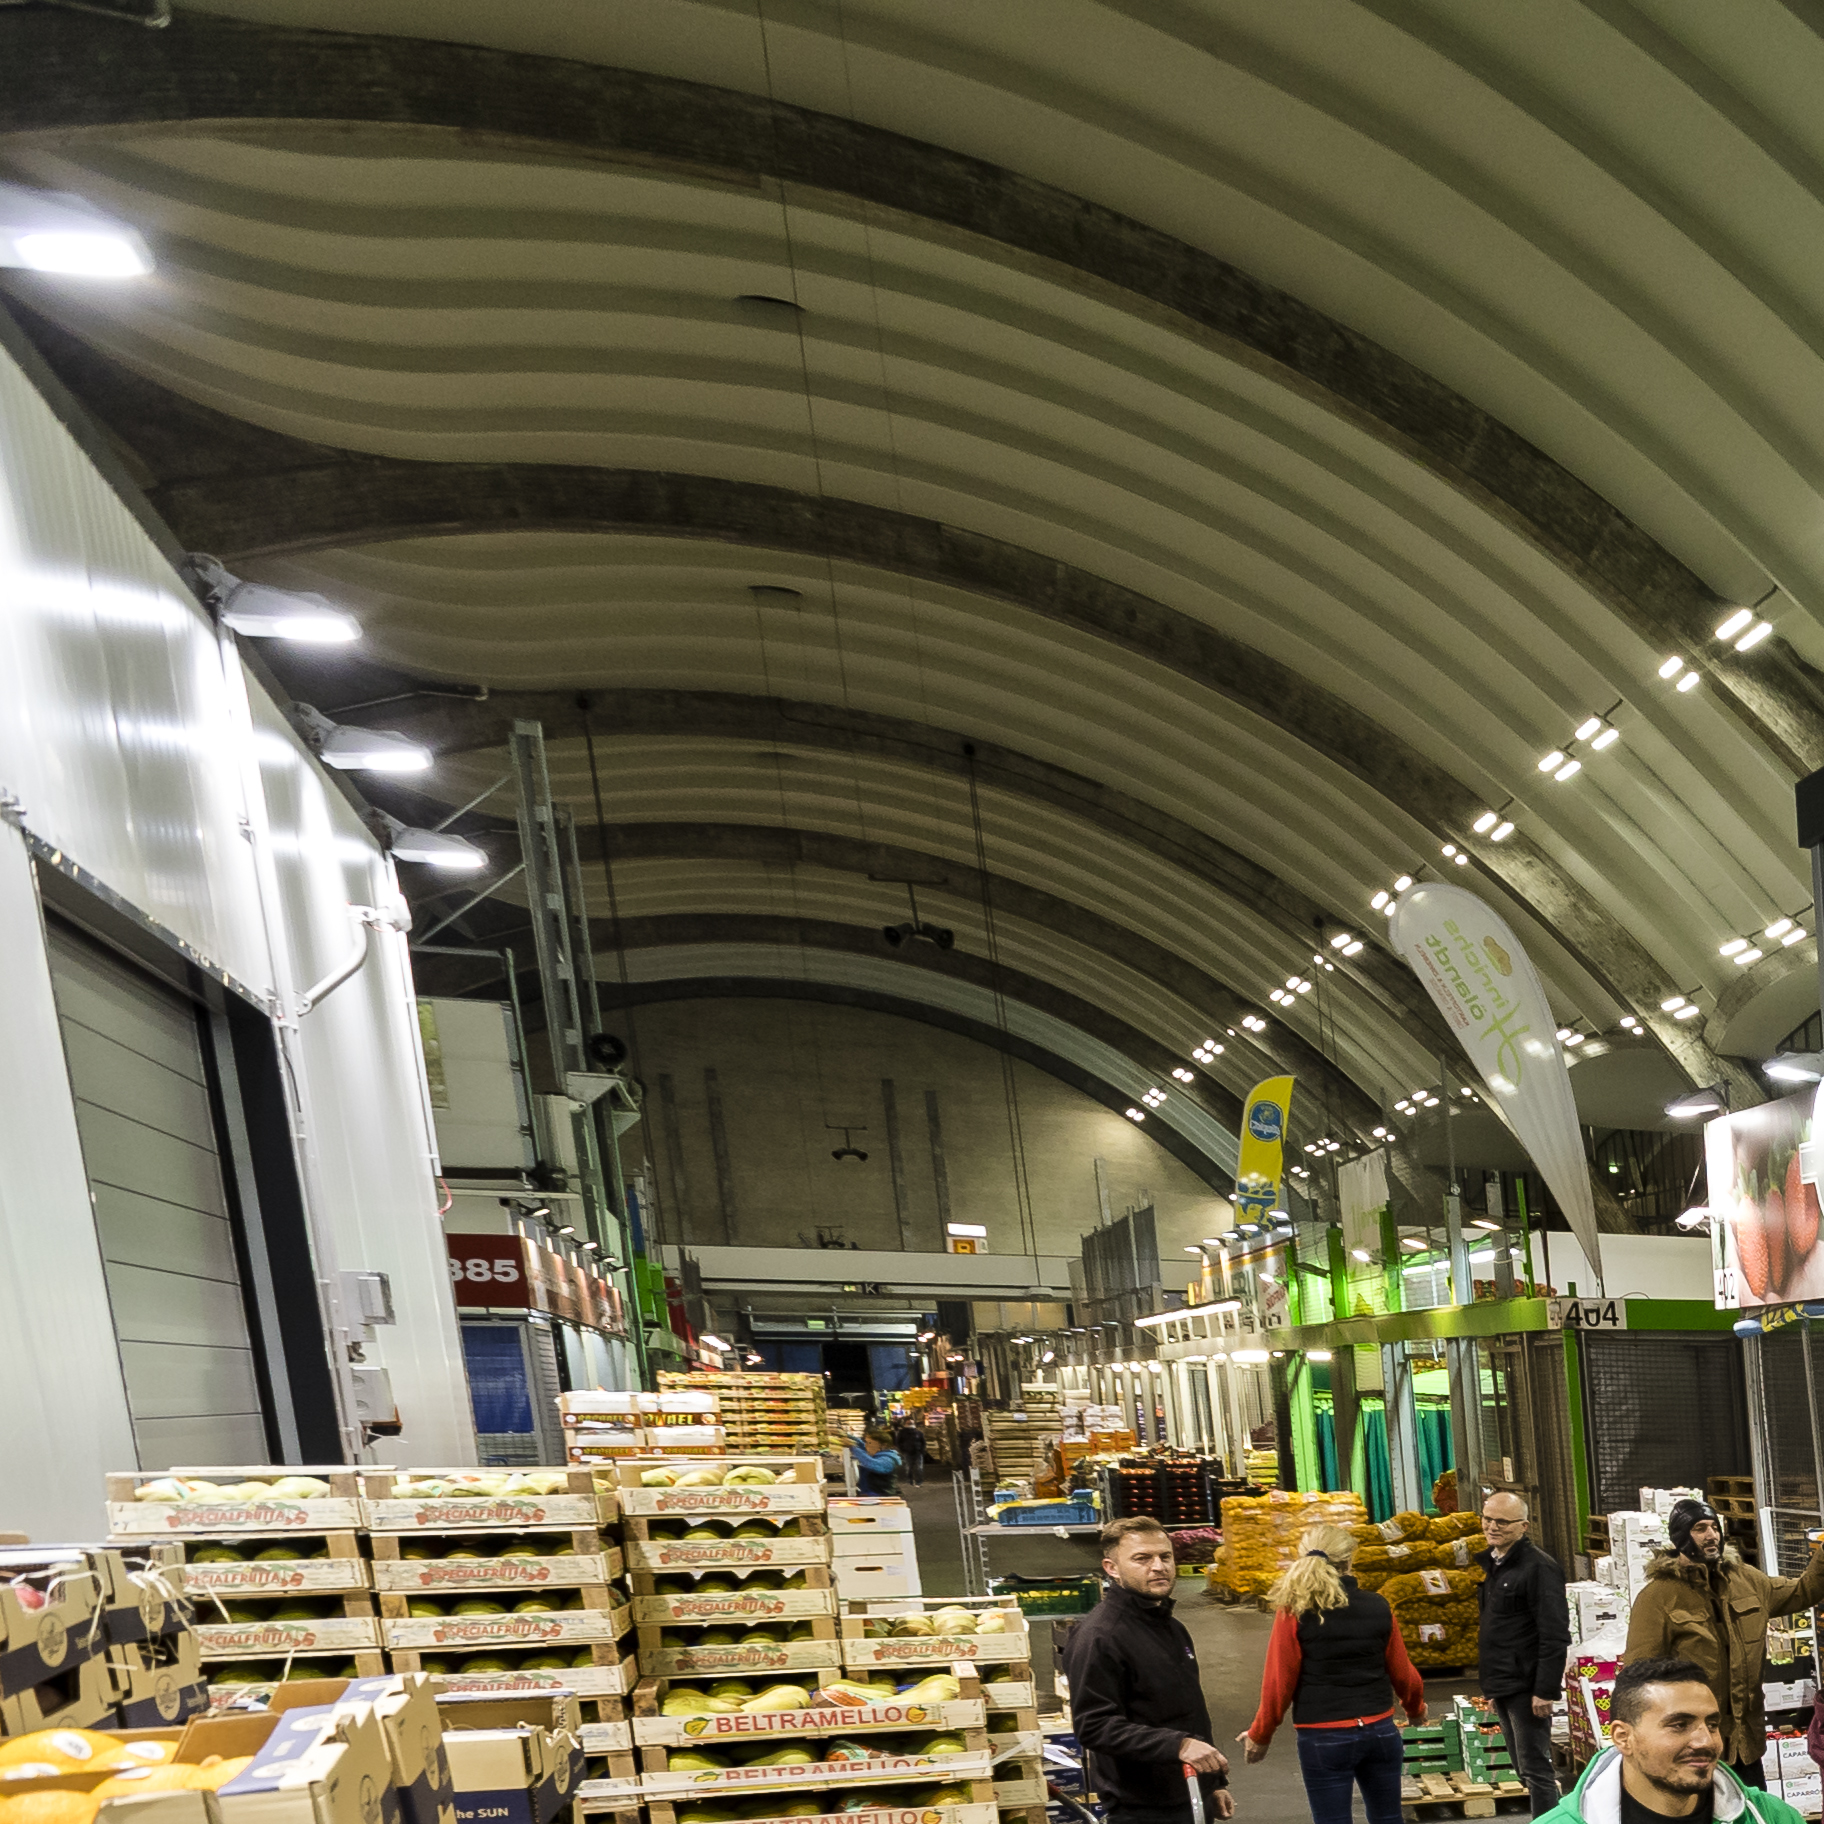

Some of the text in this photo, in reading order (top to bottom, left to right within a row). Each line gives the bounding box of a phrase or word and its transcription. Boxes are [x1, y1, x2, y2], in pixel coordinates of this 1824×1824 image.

[1566, 1303, 1619, 1327] 404
[716, 1705, 902, 1734] BELTRAMELLO
[477, 1806, 509, 1819] SUN
